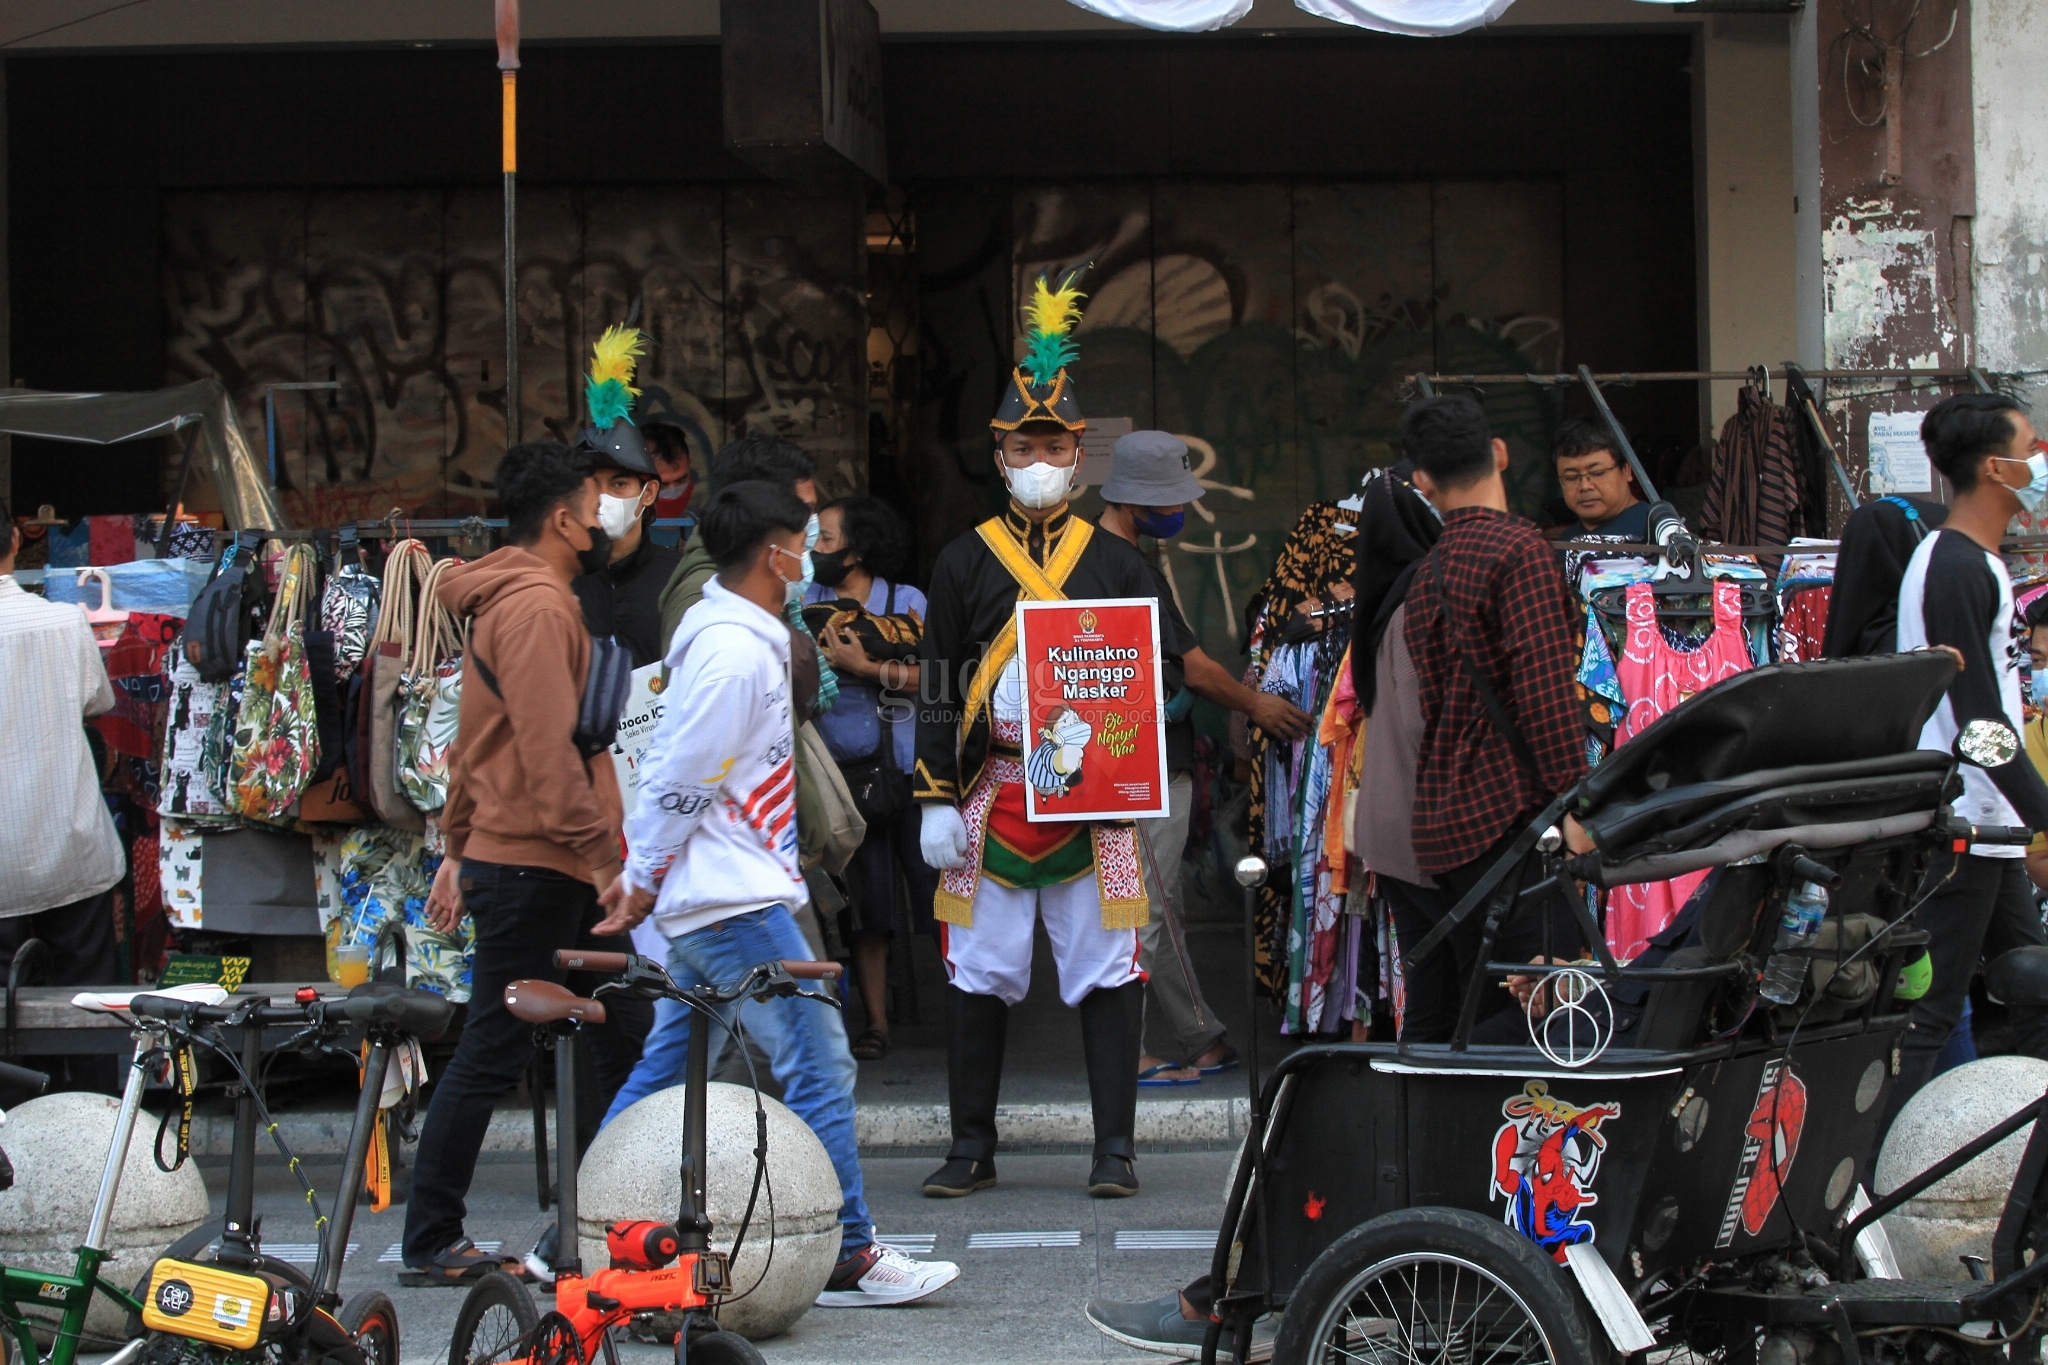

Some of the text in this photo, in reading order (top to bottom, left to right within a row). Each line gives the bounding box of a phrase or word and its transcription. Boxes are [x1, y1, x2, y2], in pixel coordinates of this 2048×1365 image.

[1048, 645, 1138, 662] Kulinakno
[1054, 665, 1135, 684] Nganggo
[1063, 683, 1128, 699] Masker
[1104, 712, 1123, 732] Ojo
[1097, 723, 1139, 750] Ngeyel
[1111, 743, 1135, 758] Wae
[627, 756, 634, 769] 1
